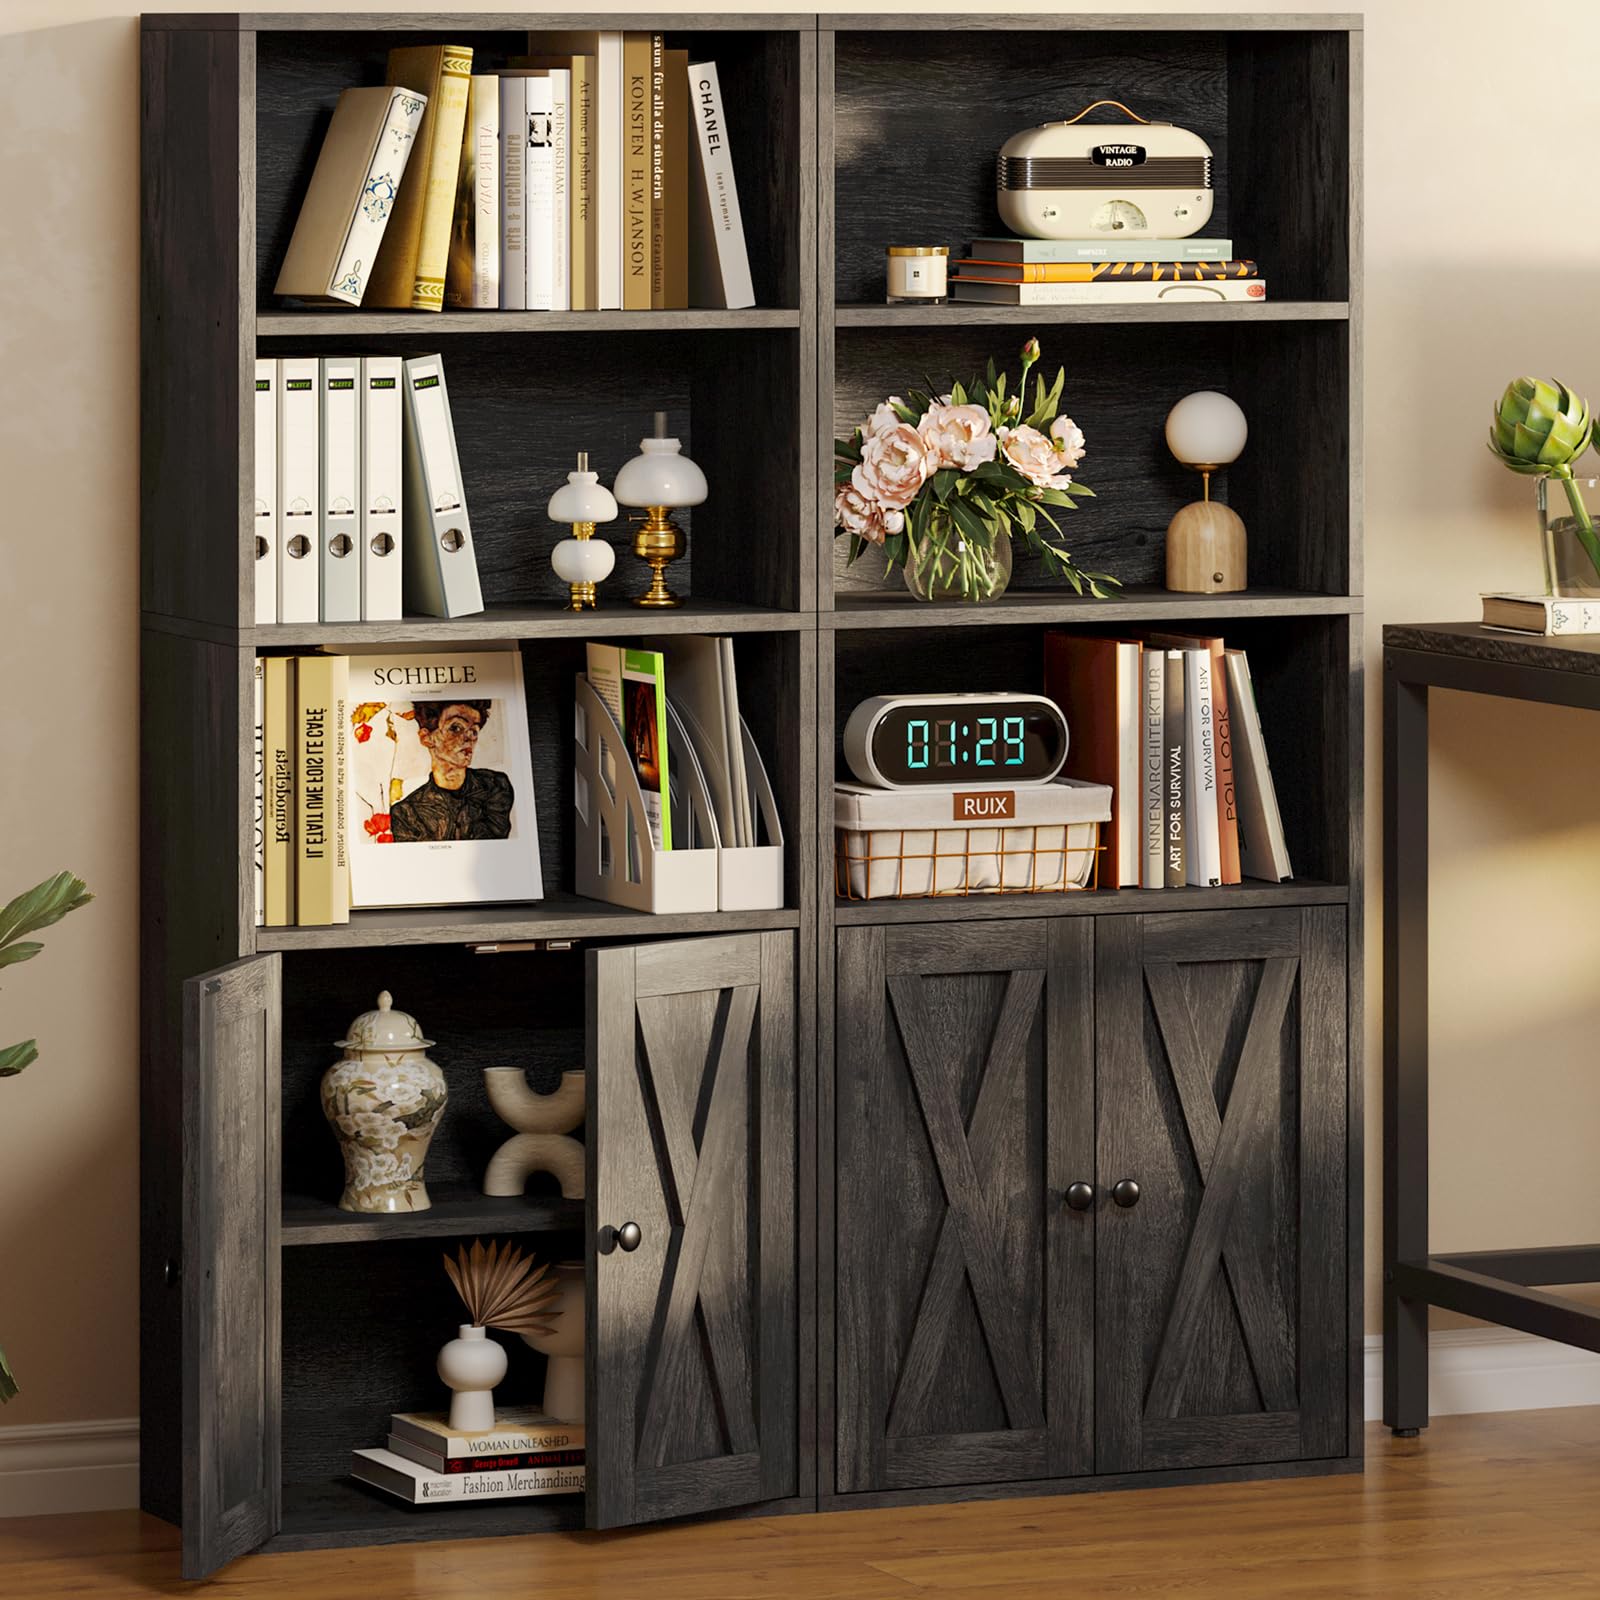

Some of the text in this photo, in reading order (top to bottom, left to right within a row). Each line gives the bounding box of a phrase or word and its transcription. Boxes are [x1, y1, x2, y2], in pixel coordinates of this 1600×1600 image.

[554, 102, 565, 136] JOHN
[631, 76, 645, 156] KONSTEN
[653, 35, 664, 199] saum für alla die sünderin
[699, 80, 721, 156] CHANEL
[555, 137, 565, 194] GRISHAM
[577, 80, 591, 220] At Home in Joshua Tree
[1099, 146, 1138, 155] VINTAGE
[1105, 158, 1133, 167] RADIO
[504, 134, 521, 251] arts & architecture
[373, 665, 478, 686] SCHIELE
[907, 716, 1025, 769] 01:29
[1199, 666, 1214, 792] ART FOR SURVIVAL
[1148, 667, 1161, 856] INNENARCHITEKTUR
[963, 796, 1008, 816] RUIX
[1169, 745, 1182, 872] ART FOR SURVIVAL
[467, 1435, 569, 1453] WOMAN UNLEASHED
[463, 1469, 586, 1495] Fashion Merchandising
